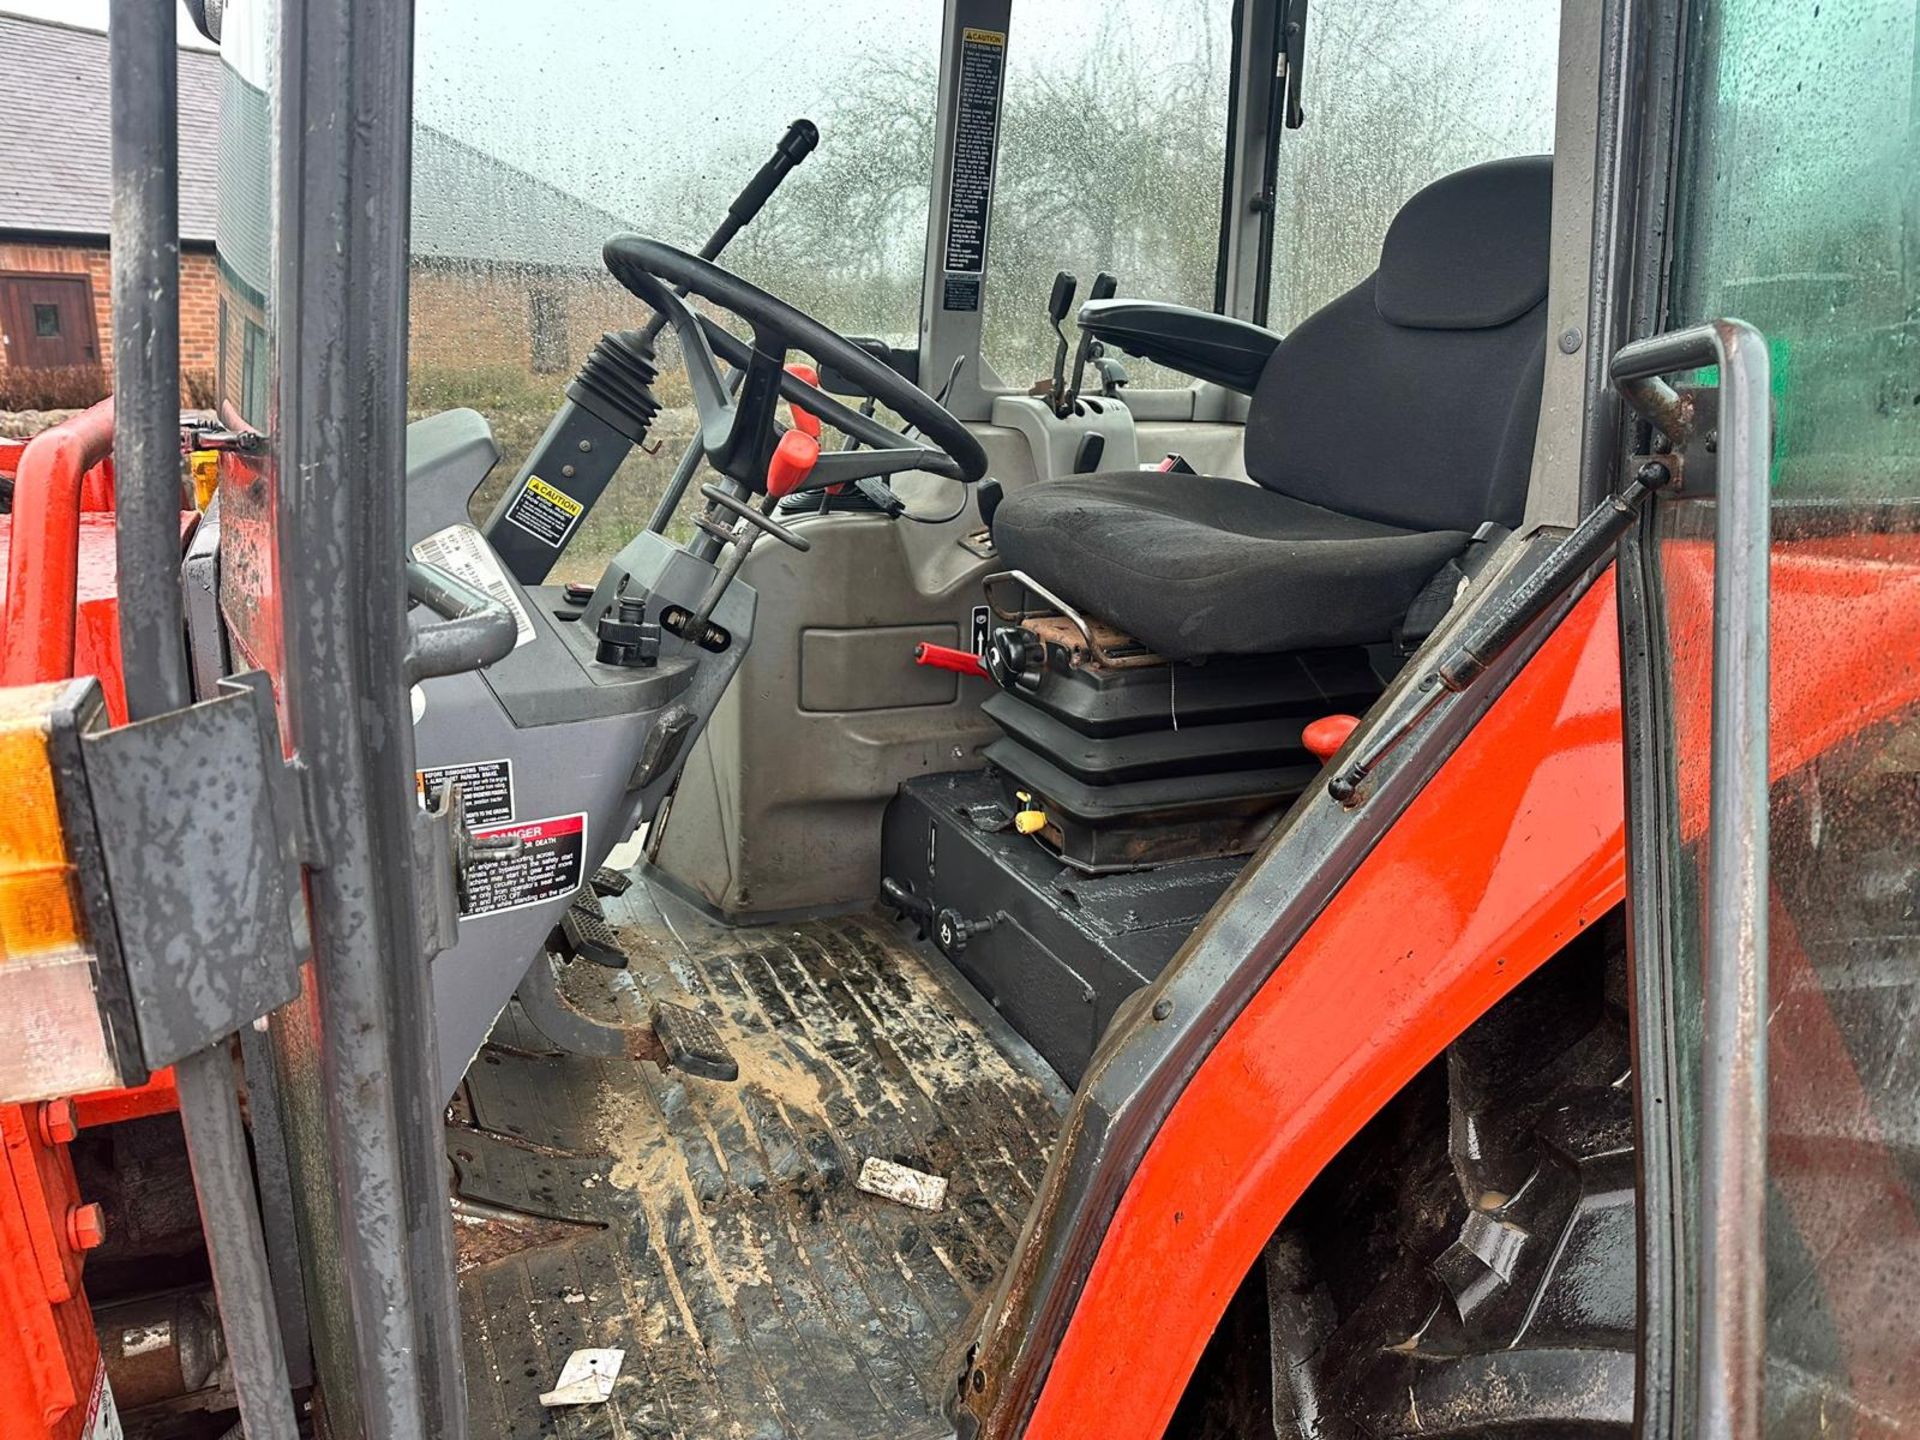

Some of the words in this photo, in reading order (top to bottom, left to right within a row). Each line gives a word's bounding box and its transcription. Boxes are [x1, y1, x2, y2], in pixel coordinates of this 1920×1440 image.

[972, 33, 1001, 43] CAUTION
[540, 486, 578, 512] CAUTION
[534, 837, 557, 847] DEATH
[477, 861, 499, 871] engine
[500, 860, 508, 868] by
[536, 851, 555, 859] across
[498, 863, 528, 875] bypassing
[530, 860, 540, 868] the
[541, 856, 560, 866] safety
[561, 852, 574, 862] start
[490, 875, 504, 884] may
[506, 871, 519, 880] start
[530, 867, 543, 877] gear
[545, 864, 556, 872] and
[558, 860, 573, 869] move
[469, 884, 492, 894] starting
[493, 879, 517, 890] circuitry
[479, 890, 492, 901] only
[494, 886, 508, 895] from
[540, 878, 553, 887] seat
[555, 874, 567, 882] with
[474, 902, 496, 913] engine
[497, 899, 513, 909] while
[514, 894, 538, 905] standing
[539, 891, 548, 899] on
[549, 888, 558, 897] the
[479, 898, 492, 908] and
[493, 894, 507, 903] PTO
